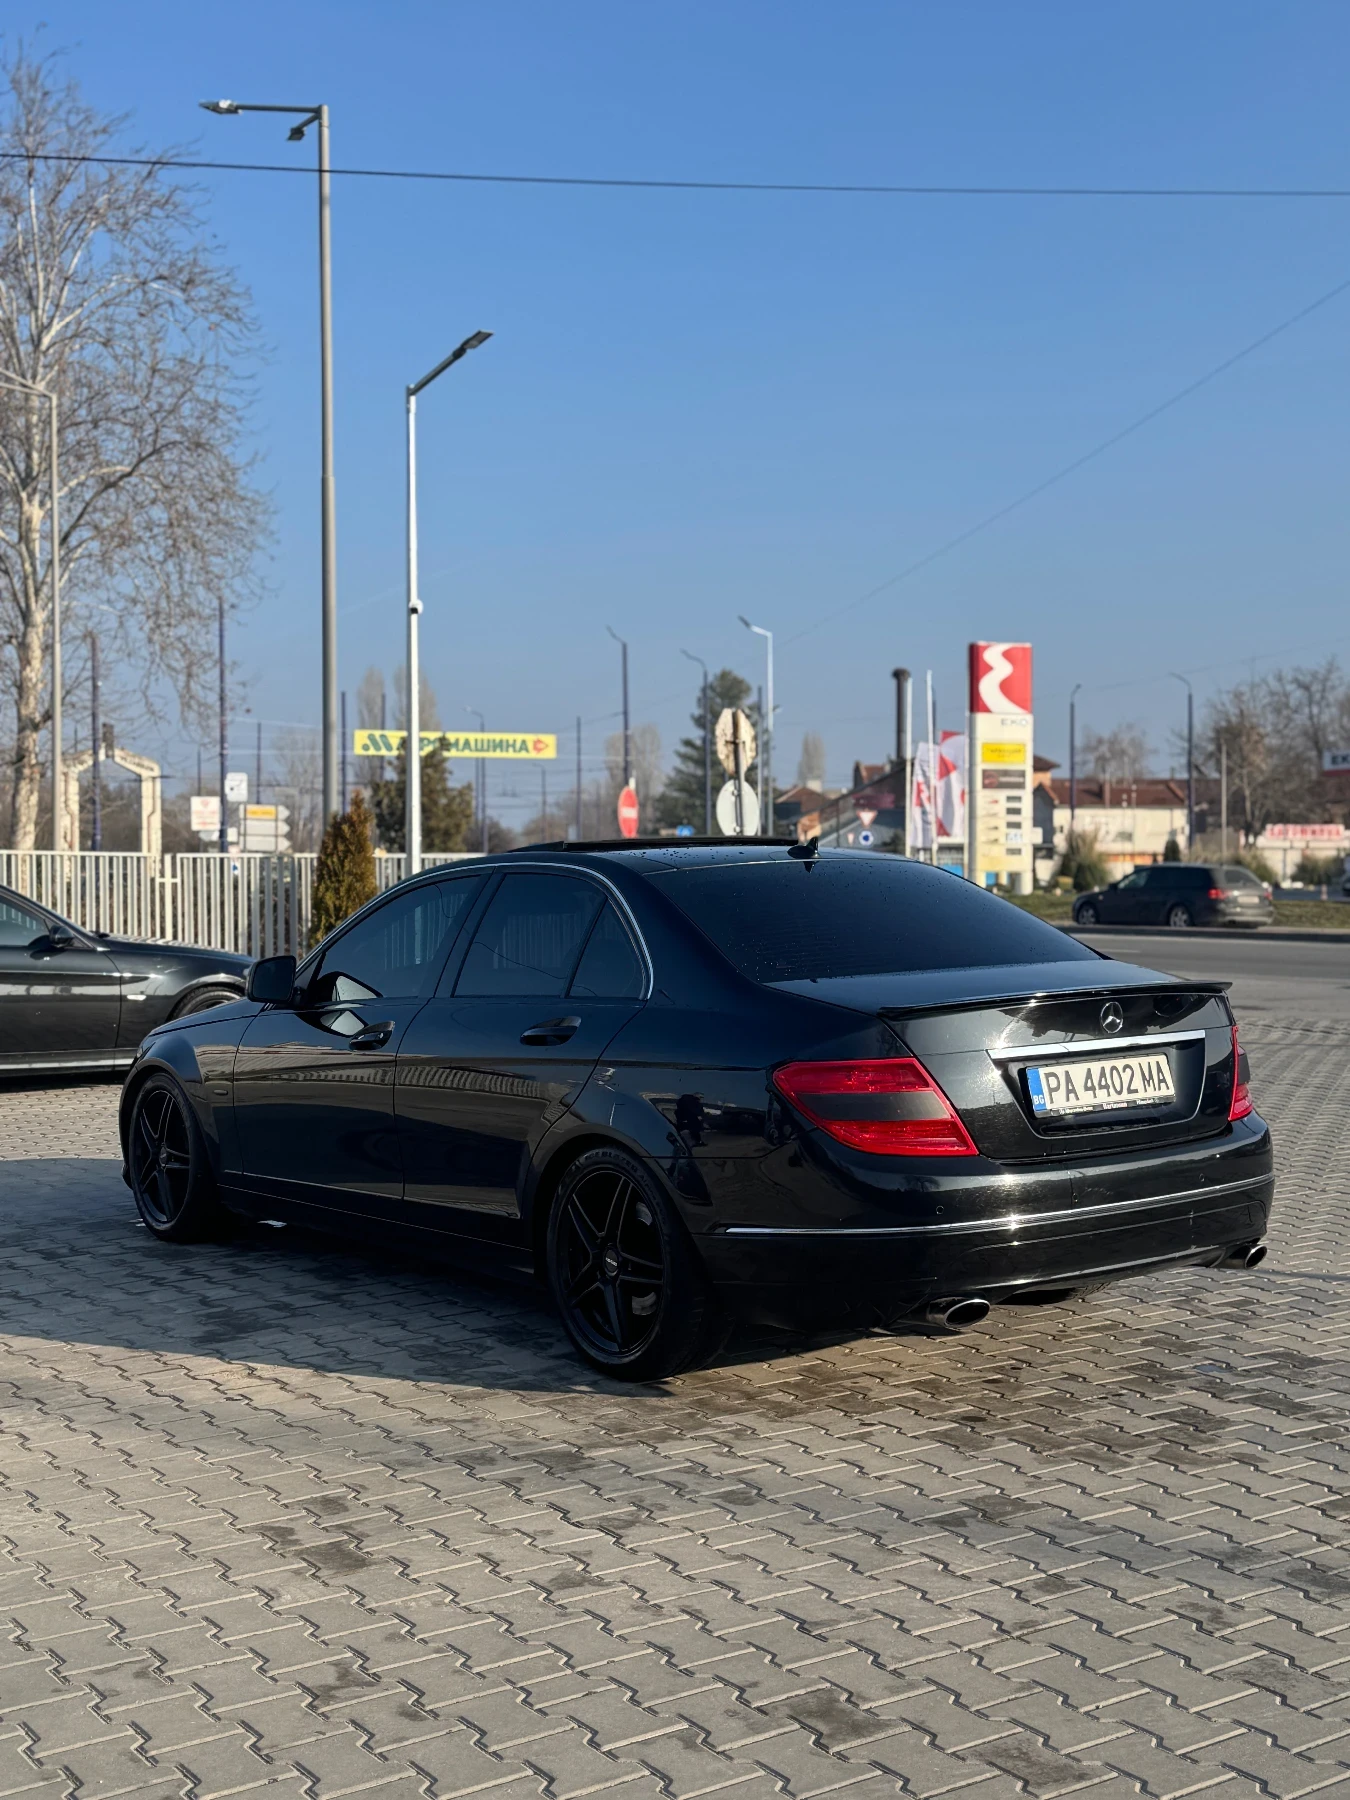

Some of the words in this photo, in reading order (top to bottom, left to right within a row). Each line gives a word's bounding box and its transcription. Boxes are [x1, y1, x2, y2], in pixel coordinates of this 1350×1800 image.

[1001, 718, 1028, 726] EKO
[396, 735, 530, 754] РОМАШИНА
[1043, 1070, 1080, 1104] PA
[1083, 1064, 1138, 1098] 4402
[1138, 1060, 1170, 1093] MA
[1033, 1094, 1045, 1105] BG
